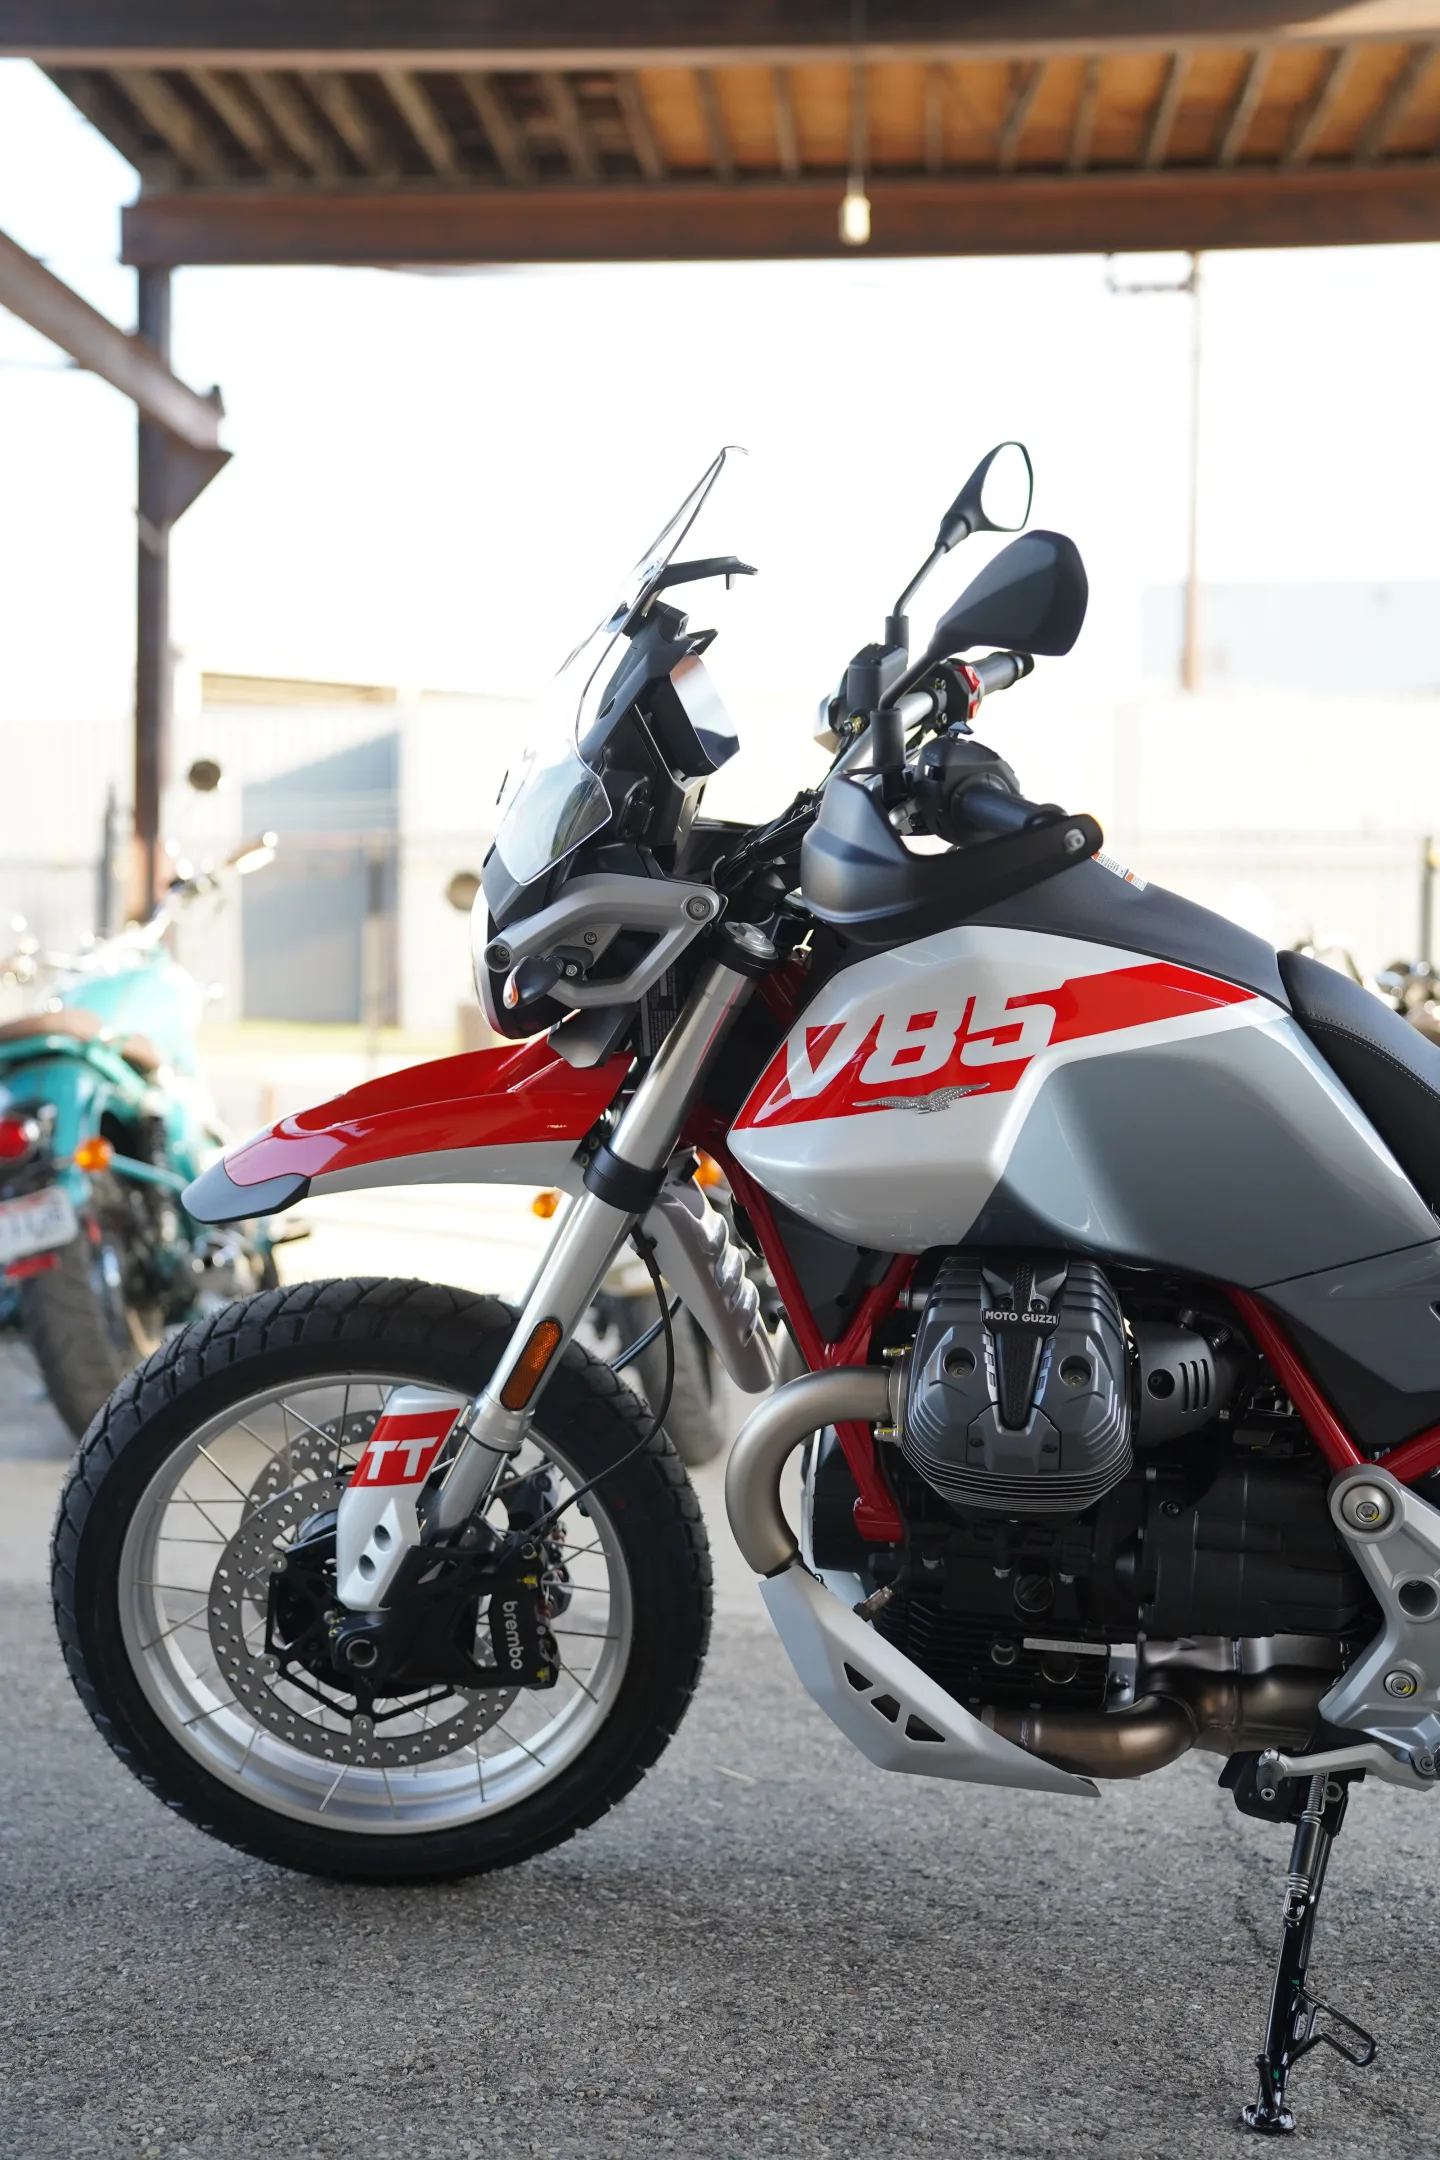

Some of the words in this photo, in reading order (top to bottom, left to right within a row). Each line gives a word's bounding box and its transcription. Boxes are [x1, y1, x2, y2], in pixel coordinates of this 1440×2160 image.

[985, 1311, 1018, 1321] MOTO
[1021, 1313, 1057, 1324] GUZZI
[366, 1436, 440, 1481] TT
[502, 1600, 524, 1671] brembo
